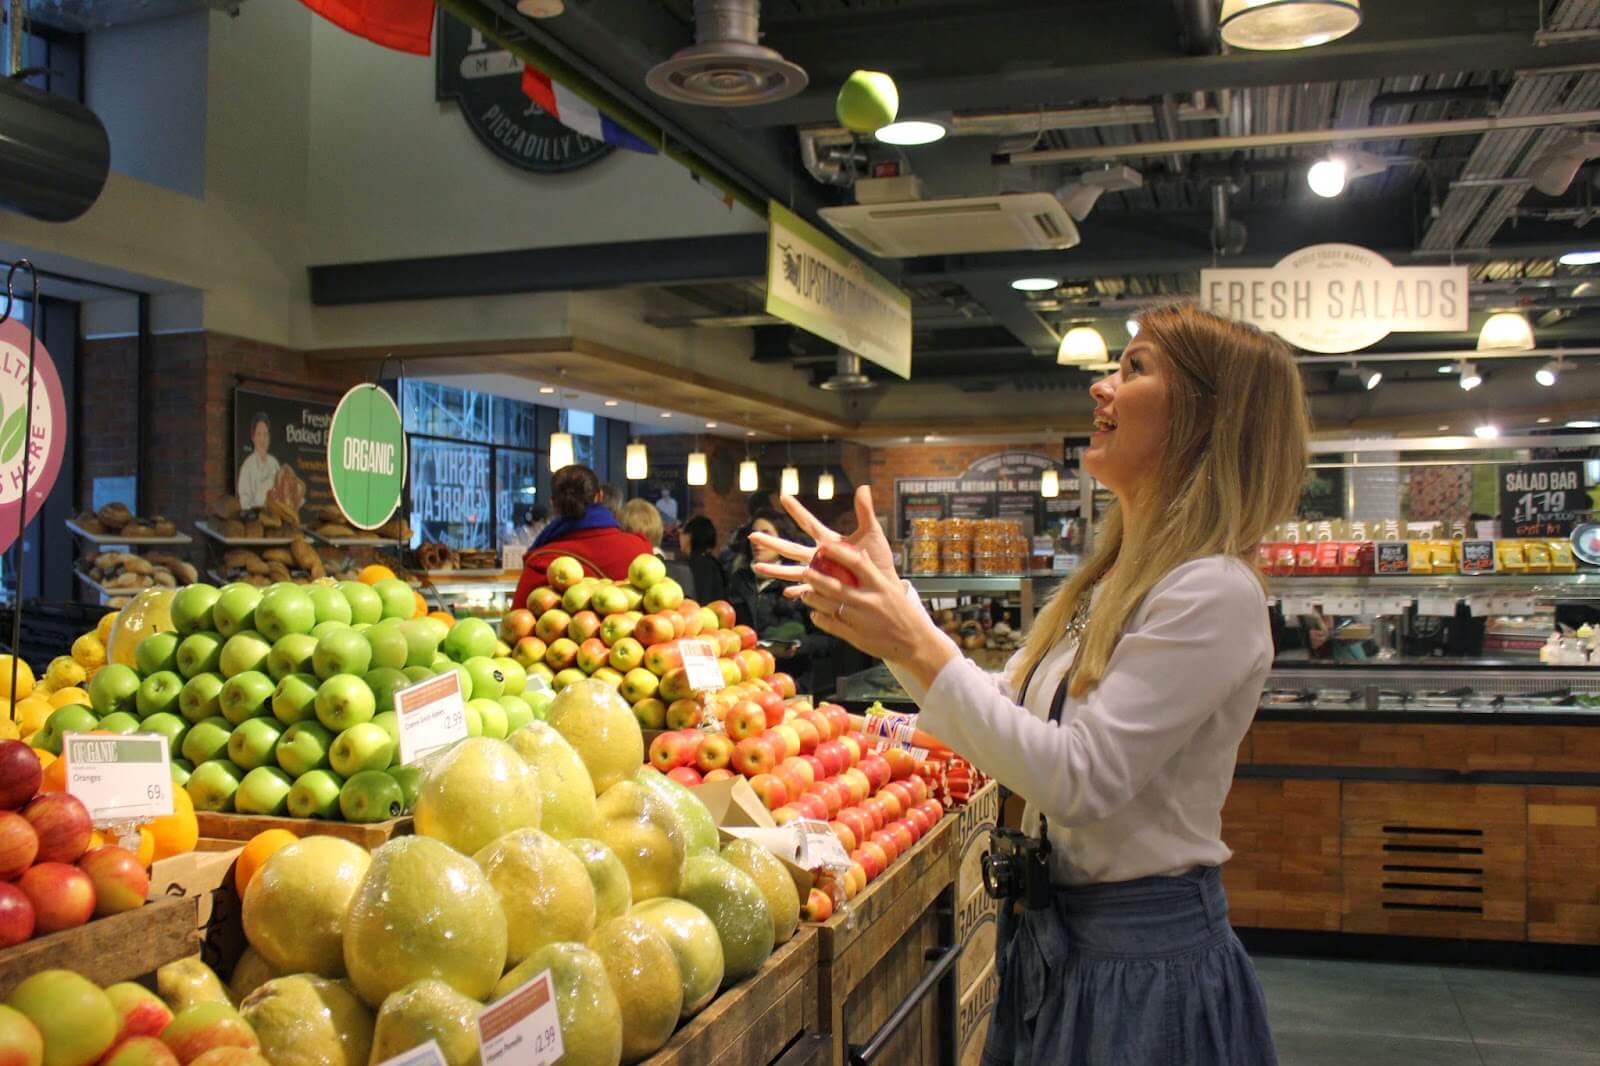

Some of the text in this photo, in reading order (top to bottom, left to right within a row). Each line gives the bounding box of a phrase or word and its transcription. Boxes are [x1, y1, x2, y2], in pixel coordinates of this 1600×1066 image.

[482, 104, 570, 161] PICCADILLY
[1210, 280, 1457, 319] FRESH SALADS
[286, 424, 322, 445] Baked
[343, 437, 394, 475] ORGANIC
[1506, 471, 1578, 492] SALAD BAR
[73, 742, 118, 763] ORGANIC
[73, 774, 102, 784] Oranges
